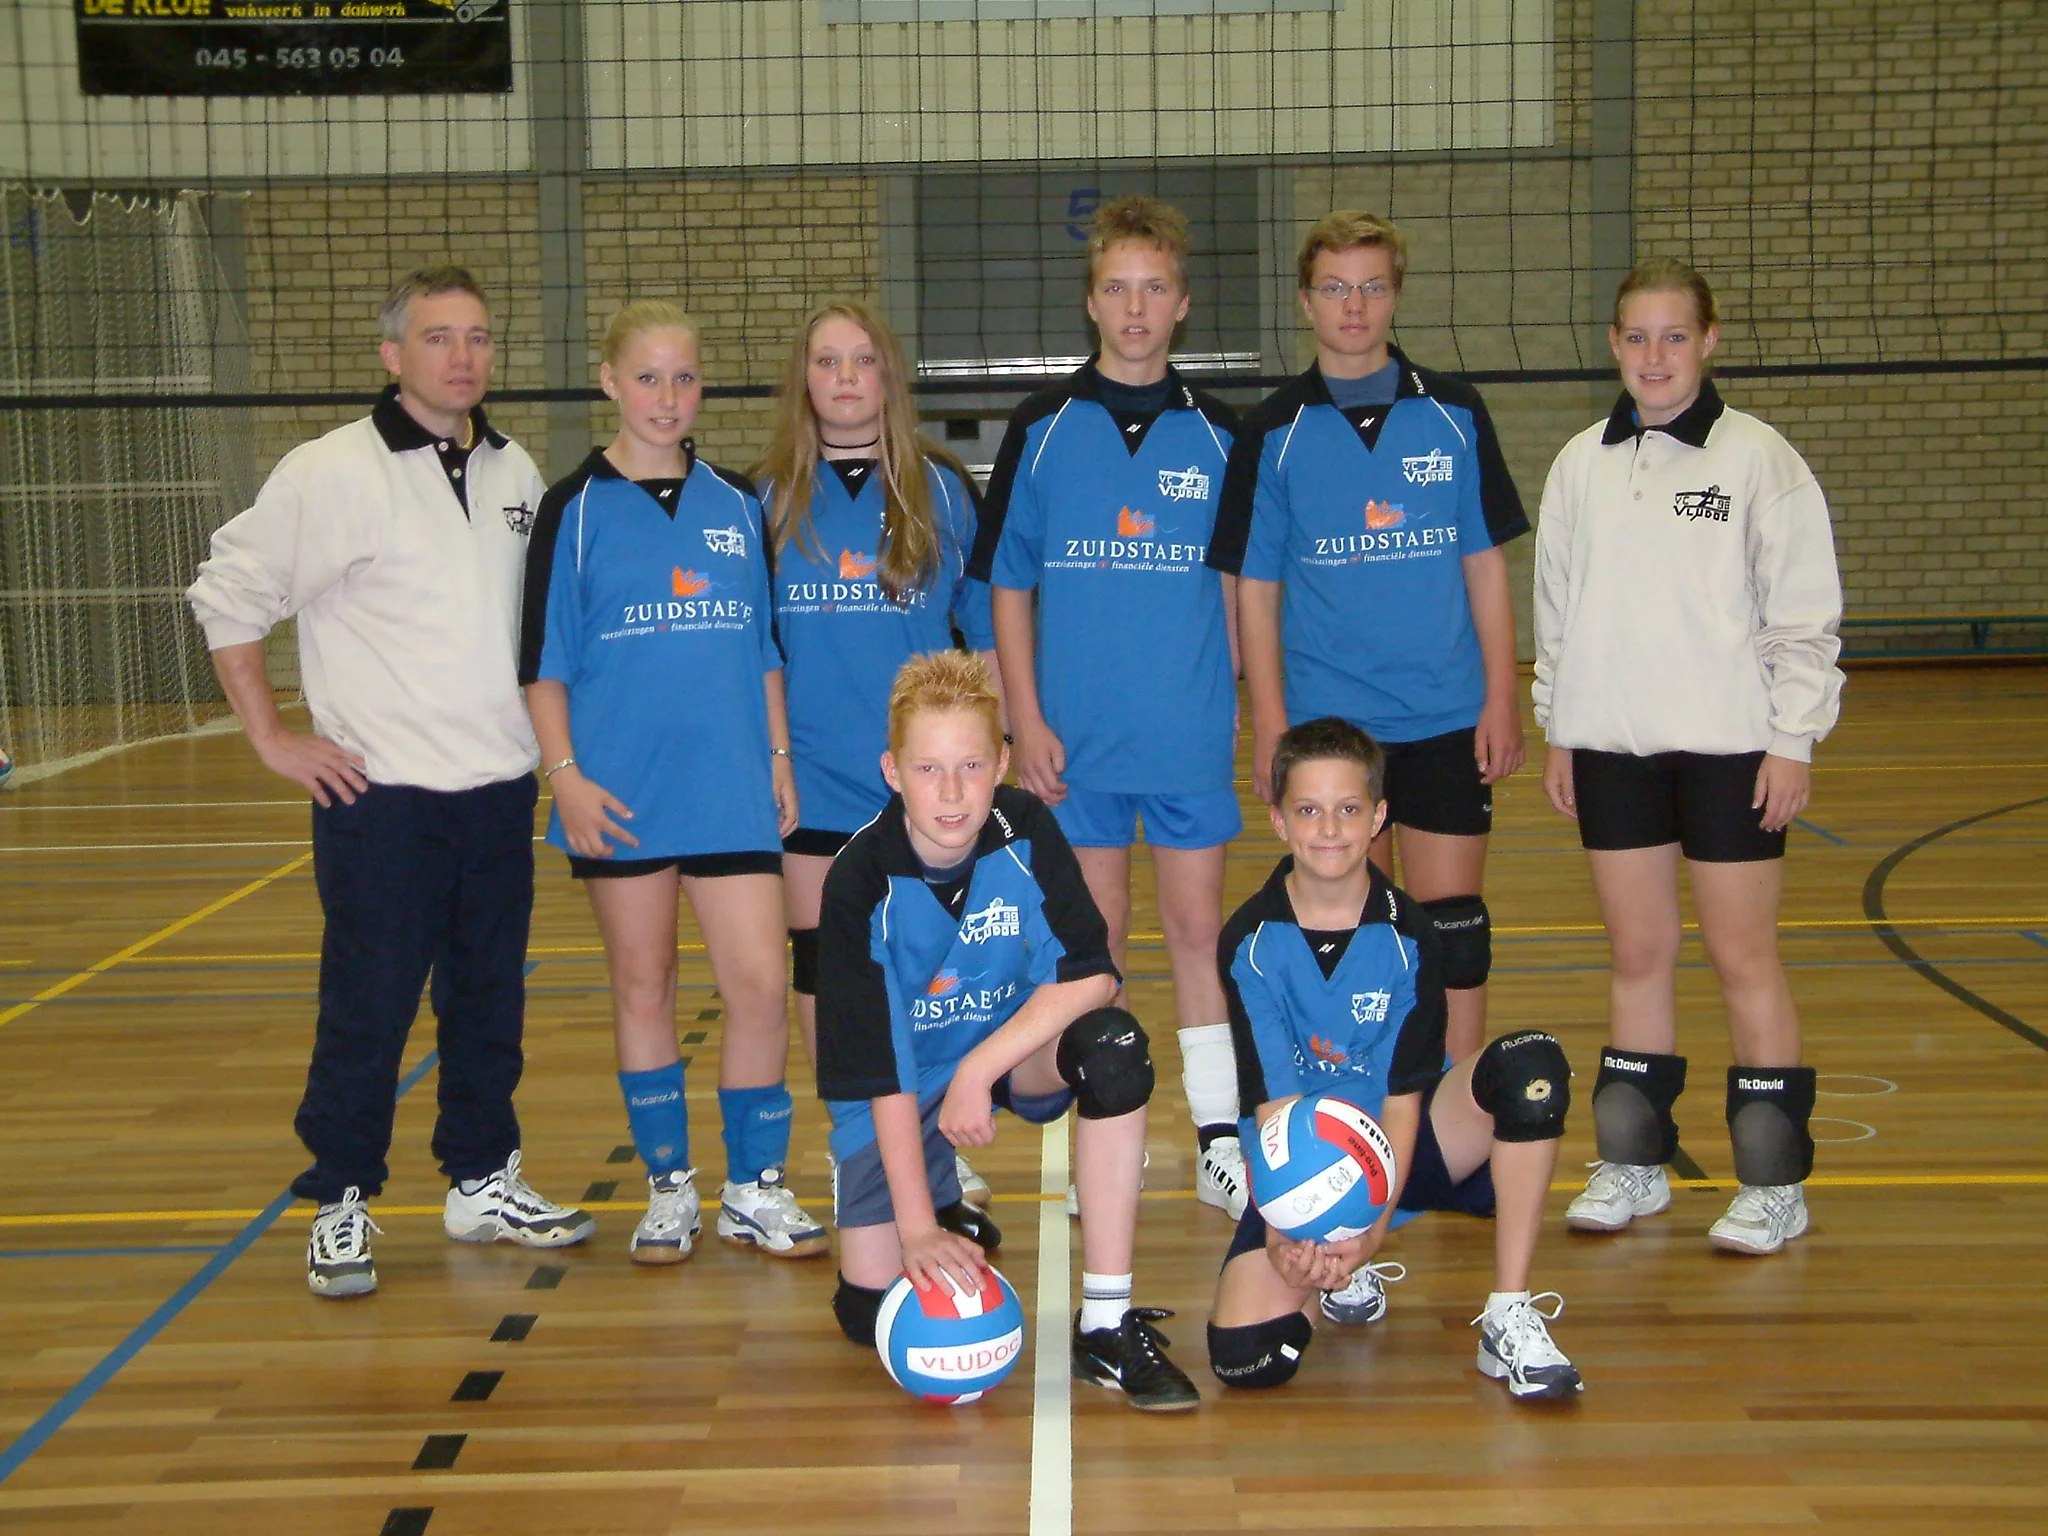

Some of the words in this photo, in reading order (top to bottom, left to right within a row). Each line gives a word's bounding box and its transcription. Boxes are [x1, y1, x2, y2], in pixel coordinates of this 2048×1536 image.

[314, 3, 331, 17] in
[195, 48, 247, 69] 045
[276, 47, 321, 69] 563
[329, 47, 360, 68] 05
[369, 47, 404, 67] 04
[1315, 526, 1458, 555] ZUIDSTAETE
[1604, 1056, 1648, 1073] McDavid
[1738, 1078, 1784, 1090] McDavid
[920, 1337, 1020, 1372] VLUDOC
